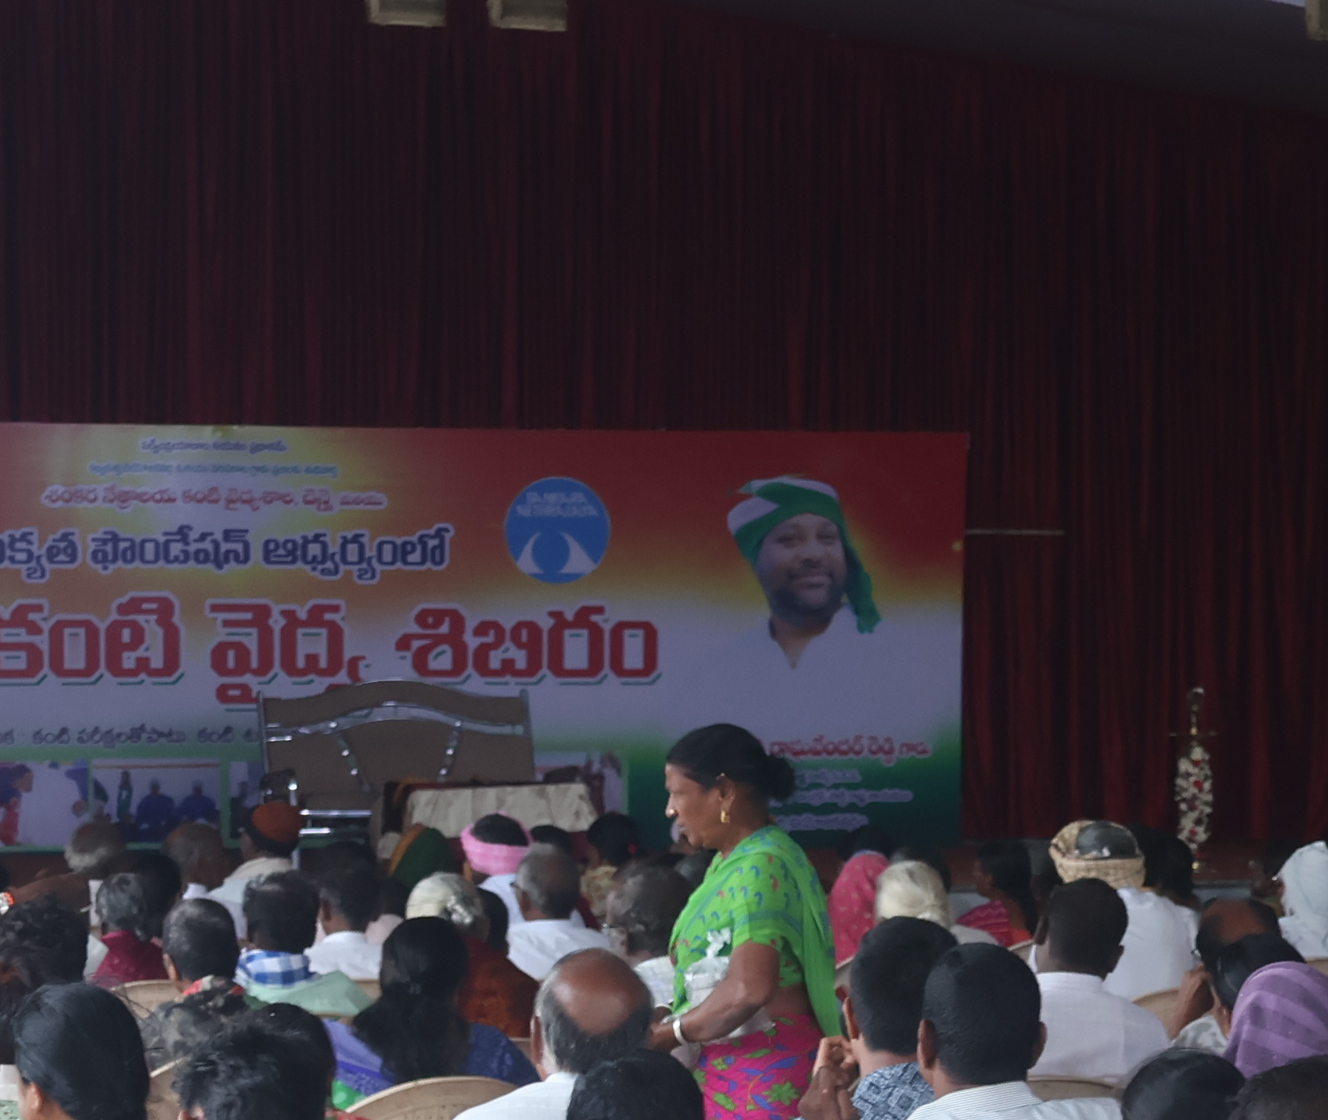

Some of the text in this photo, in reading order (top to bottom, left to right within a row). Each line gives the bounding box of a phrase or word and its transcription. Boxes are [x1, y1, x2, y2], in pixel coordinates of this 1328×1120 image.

[45, 488, 98, 504] శంకర
[182, 486, 221, 504] కంటి
[90, 524, 252, 572] ఫౌండేషన్
[261, 526, 451, 582] ఆధ్వర్యంలో
[394, 605, 661, 686] శిబిరం
[32, 726, 71, 745] కంటి
